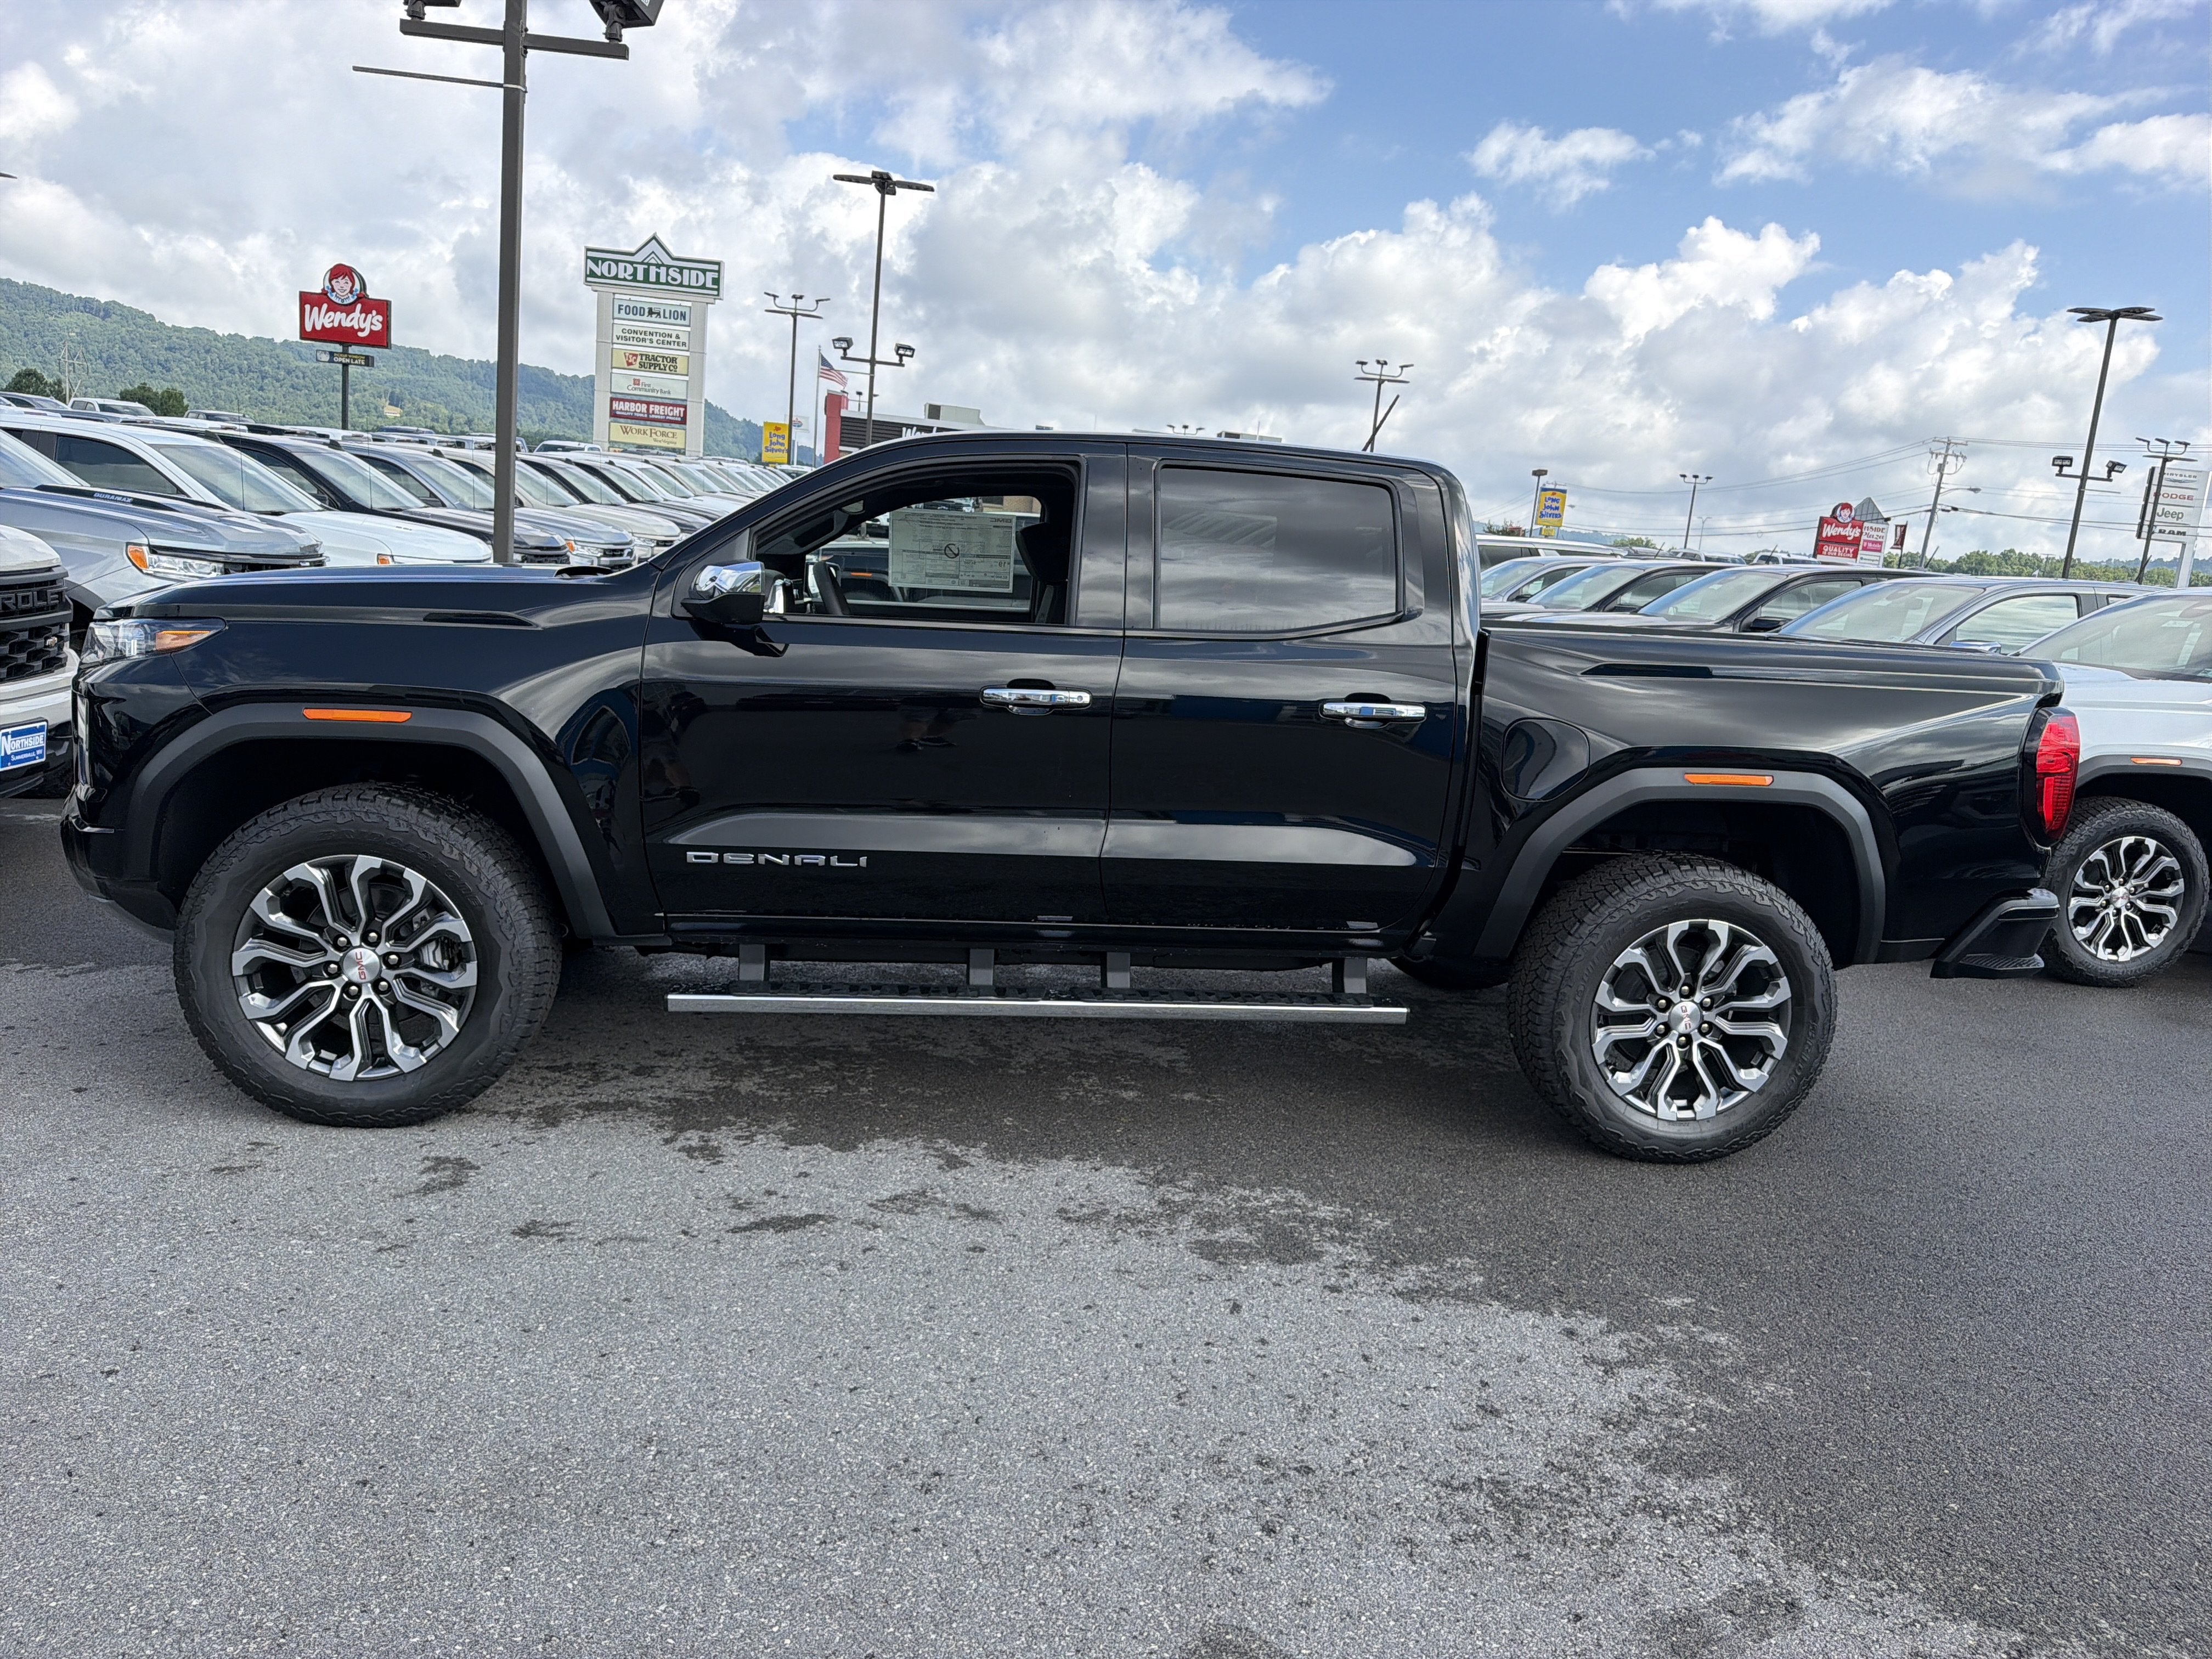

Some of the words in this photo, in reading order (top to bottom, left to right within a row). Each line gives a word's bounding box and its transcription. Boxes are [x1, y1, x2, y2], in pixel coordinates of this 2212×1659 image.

[587, 259, 718, 288] NORTHSIDE
[304, 303, 383, 337] Wendy's
[618, 304, 645, 316] FOOD
[663, 309, 686, 321] LION
[616, 335, 653, 343] VISITOR'S
[656, 339, 686, 347] CENTER
[622, 328, 672, 338] CONVENTION
[625, 353, 636, 364] TSC
[639, 353, 678, 364] TRACTOR
[639, 362, 667, 371] SUPPLY
[627, 385, 659, 394] Community
[613, 400, 647, 413] HARBOR
[650, 404, 685, 417] FREIGHT
[769, 432, 785, 440] Long
[93, 493, 132, 503] DURAMAX
[2157, 507, 2184, 521] Jeep
[1822, 523, 1861, 540] Wendy's
[0, 587, 67, 611] ROLET
[1, 735, 44, 756] NORTHSIDE
[686, 851, 867, 867] DENALI
[355, 951, 366, 980] GMC
[1680, 1005, 1691, 1030] GMC
